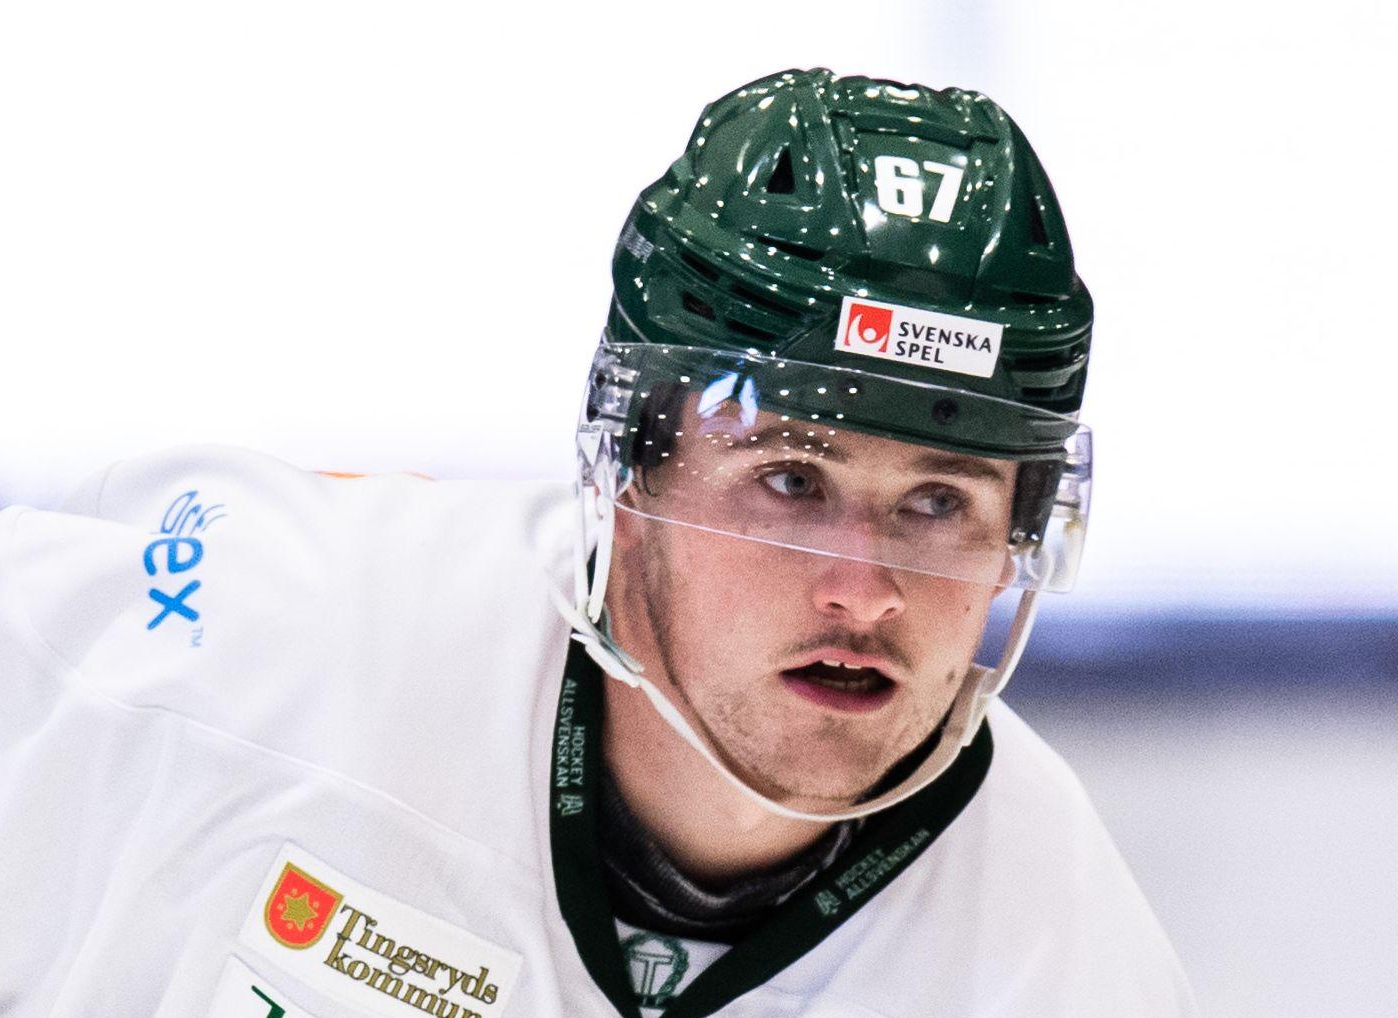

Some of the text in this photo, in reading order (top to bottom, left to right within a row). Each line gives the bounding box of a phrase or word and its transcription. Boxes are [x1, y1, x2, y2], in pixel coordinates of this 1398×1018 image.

[874, 153, 969, 223] 67
[895, 340, 945, 364] SPEL
[898, 321, 993, 353] SVENSKA
[555, 678, 578, 788] ALLSVENSKAN
[570, 725, 586, 786] HOCKEY
[339, 903, 500, 1005] Tingsryds
